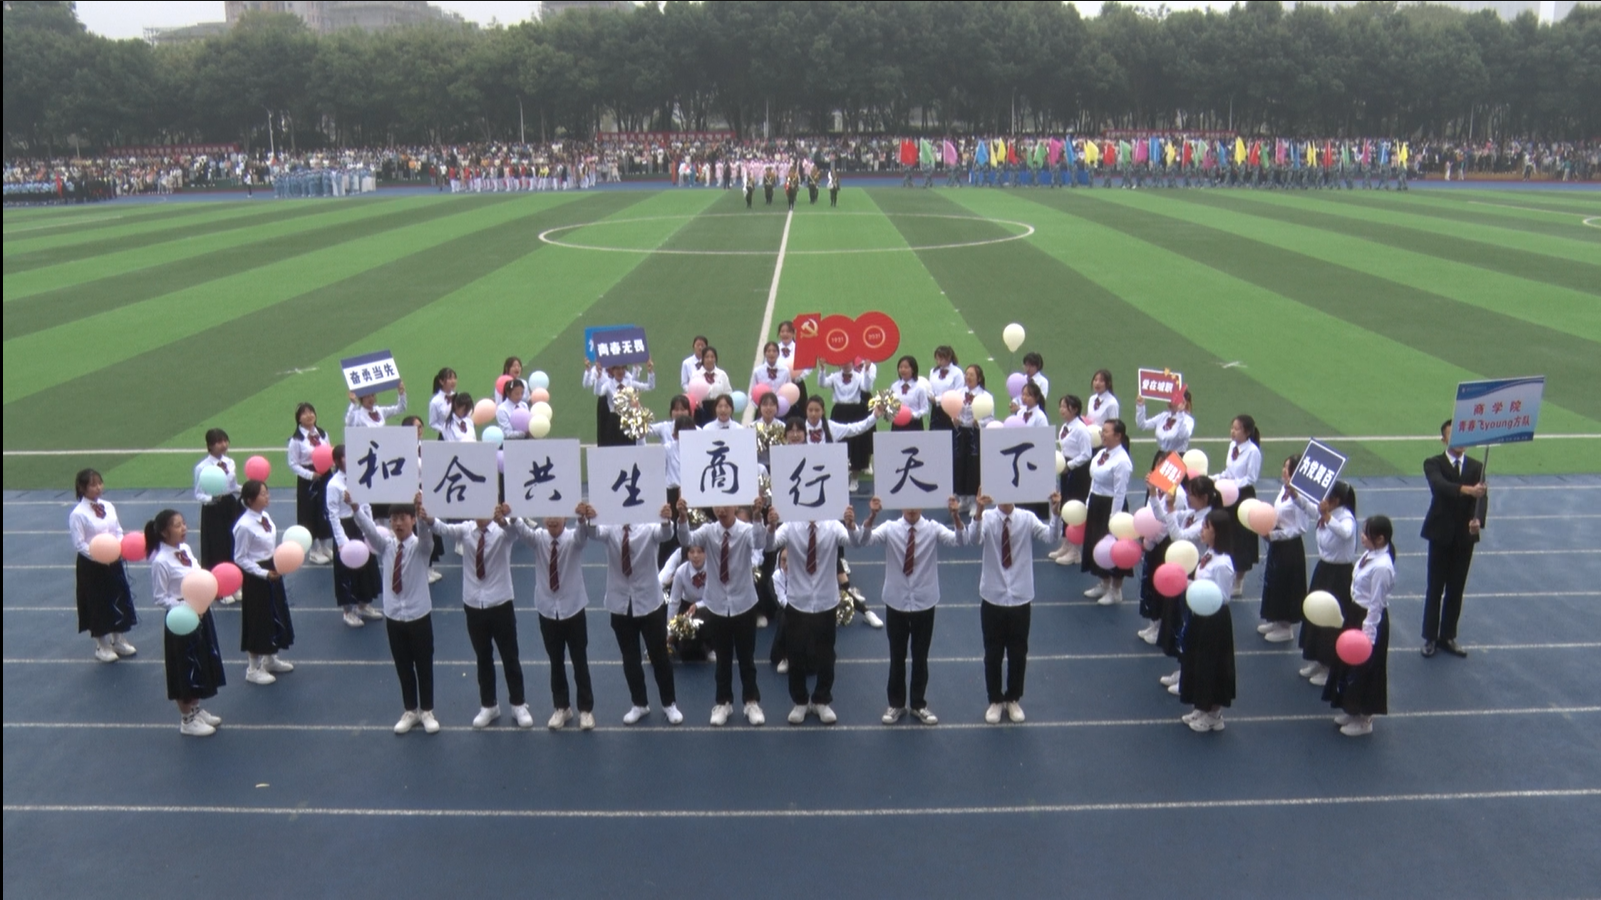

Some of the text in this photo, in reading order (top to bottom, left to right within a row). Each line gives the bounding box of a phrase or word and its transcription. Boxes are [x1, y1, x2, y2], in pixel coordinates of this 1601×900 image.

[597, 338, 645, 357] 青春无畏
[349, 362, 396, 385] 奋勇当先
[357, 440, 1038, 508] 和 合 共 生 商 行 天 下
